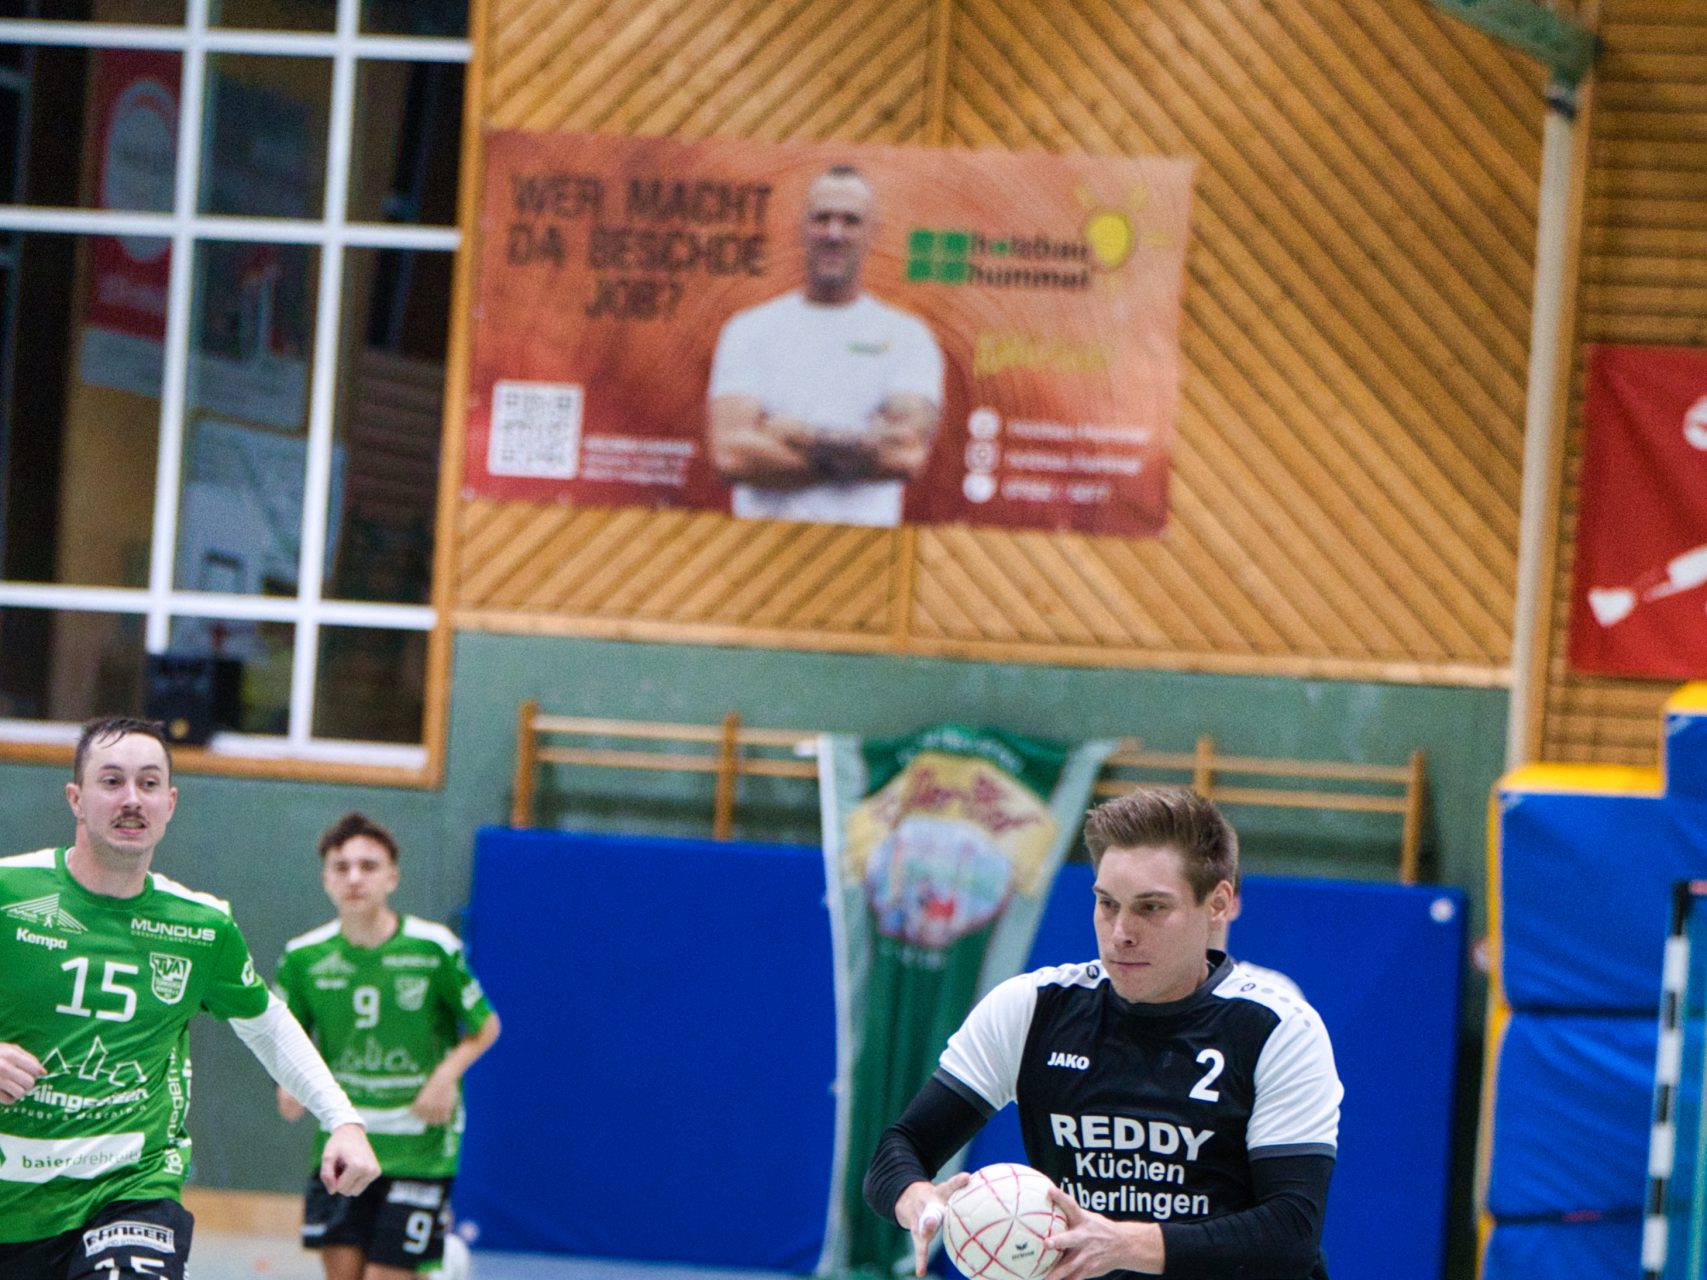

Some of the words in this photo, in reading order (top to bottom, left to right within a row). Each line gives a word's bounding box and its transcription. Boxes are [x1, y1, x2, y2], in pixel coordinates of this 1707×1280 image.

[511, 172, 605, 222] WER
[626, 177, 772, 228] MACHT
[506, 223, 566, 268] DA
[16, 927, 68, 950] Kempa
[130, 918, 216, 942] MUNDUS
[56, 956, 139, 1023] 15
[353, 985, 380, 1029] 9
[1047, 1051, 1091, 1071] JAKO
[1189, 1048, 1226, 1103] 2
[1050, 1113, 1215, 1162] REDDY
[1075, 1152, 1185, 1185] Küchen
[1060, 1177, 1209, 1220] Überlingen
[402, 1210, 433, 1255] 9
